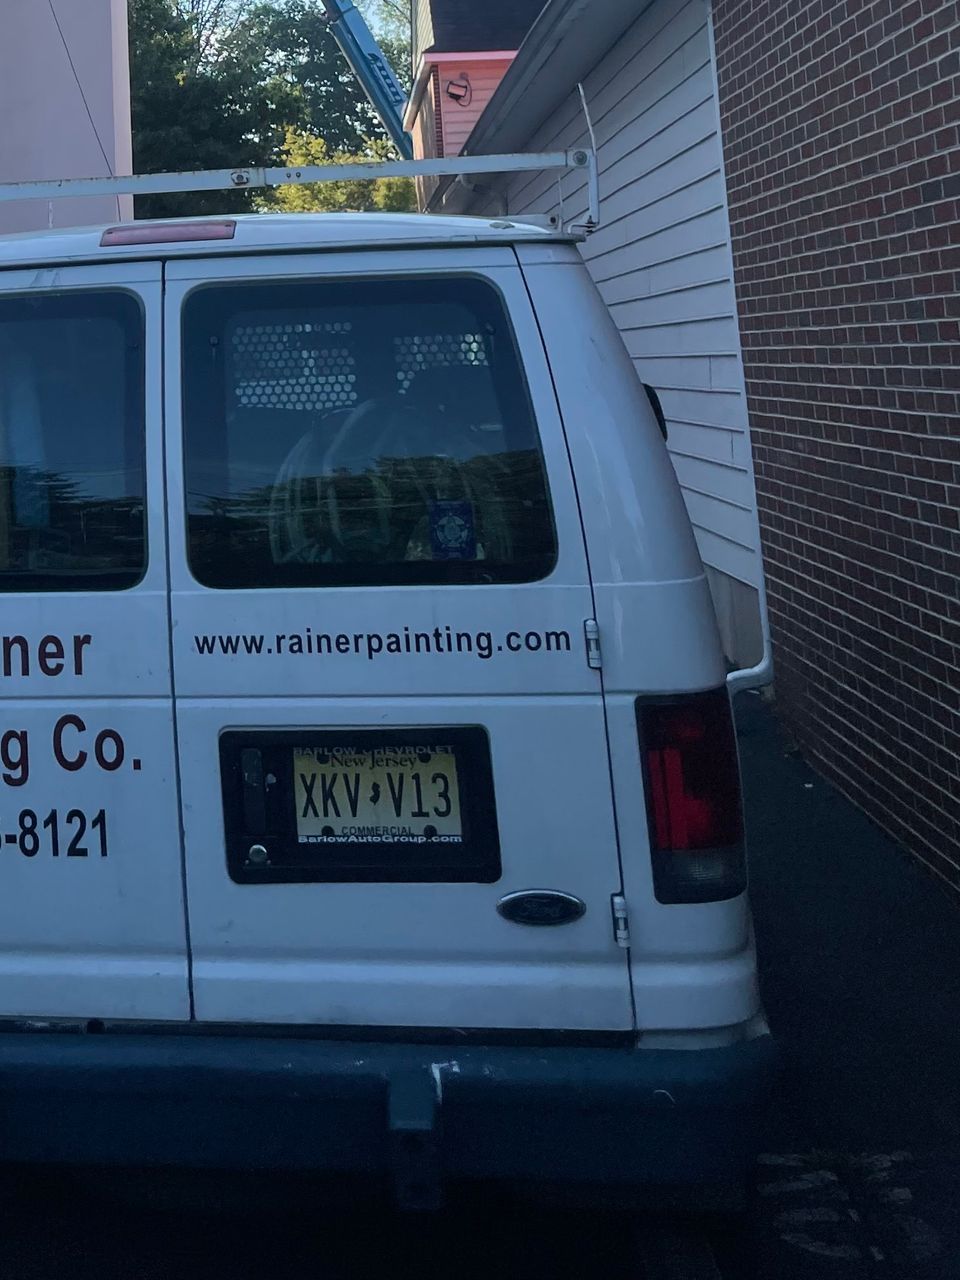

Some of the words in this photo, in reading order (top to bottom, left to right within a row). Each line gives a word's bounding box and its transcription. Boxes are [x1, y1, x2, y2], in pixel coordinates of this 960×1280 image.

[194, 626, 571, 659] www.rainerpainting.com
[53, 714, 142, 771] Co.
[330, 755, 367, 768] New
[369, 752, 417, 770] Jersey
[300, 773, 360, 817] XKV
[387, 773, 452, 817] V13
[298, 834, 463, 844] BarlowAutoGroup.com
[341, 825, 414, 836] COMMERCIAL
